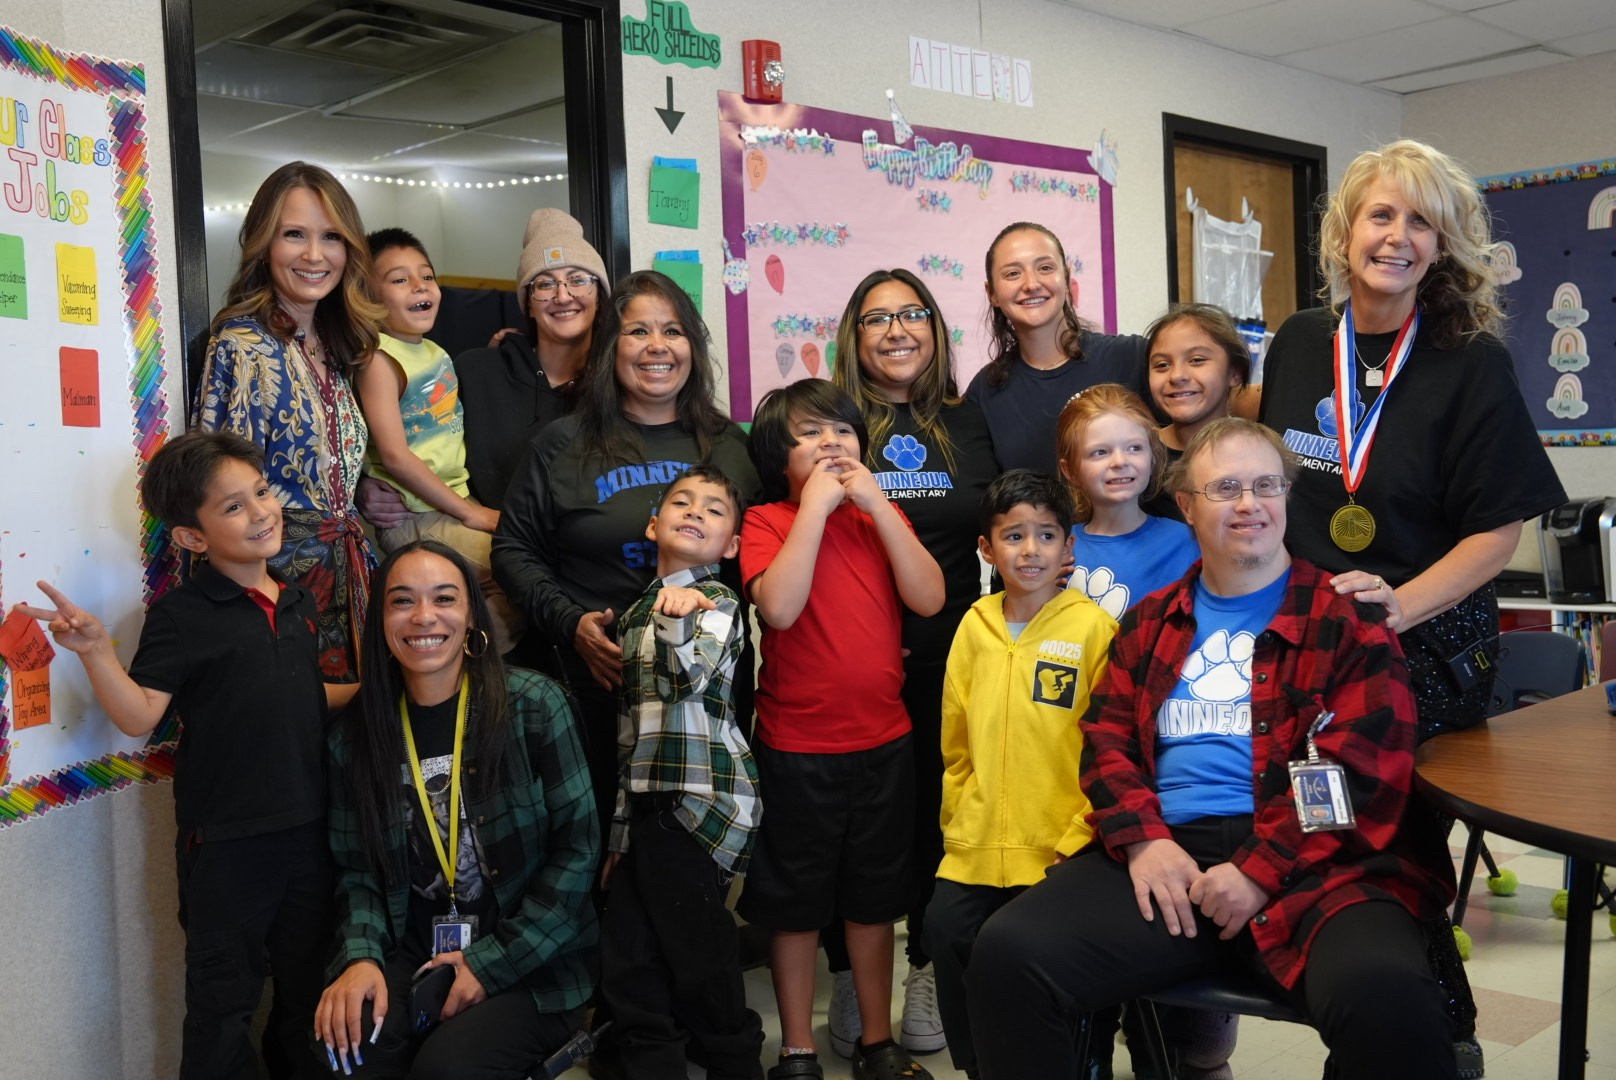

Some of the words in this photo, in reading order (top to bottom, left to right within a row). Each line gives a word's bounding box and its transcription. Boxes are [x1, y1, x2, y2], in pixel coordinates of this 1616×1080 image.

[651, 2, 691, 34] FULL
[622, 21, 660, 54] HERO
[664, 31, 721, 63] SHIELDS
[39, 99, 111, 166] Class
[4, 148, 89, 225] Jobs
[862, 131, 917, 189] Happy
[914, 138, 993, 199] Birthday
[595, 460, 694, 503] MINNE
[1039, 639, 1083, 660] #0025
